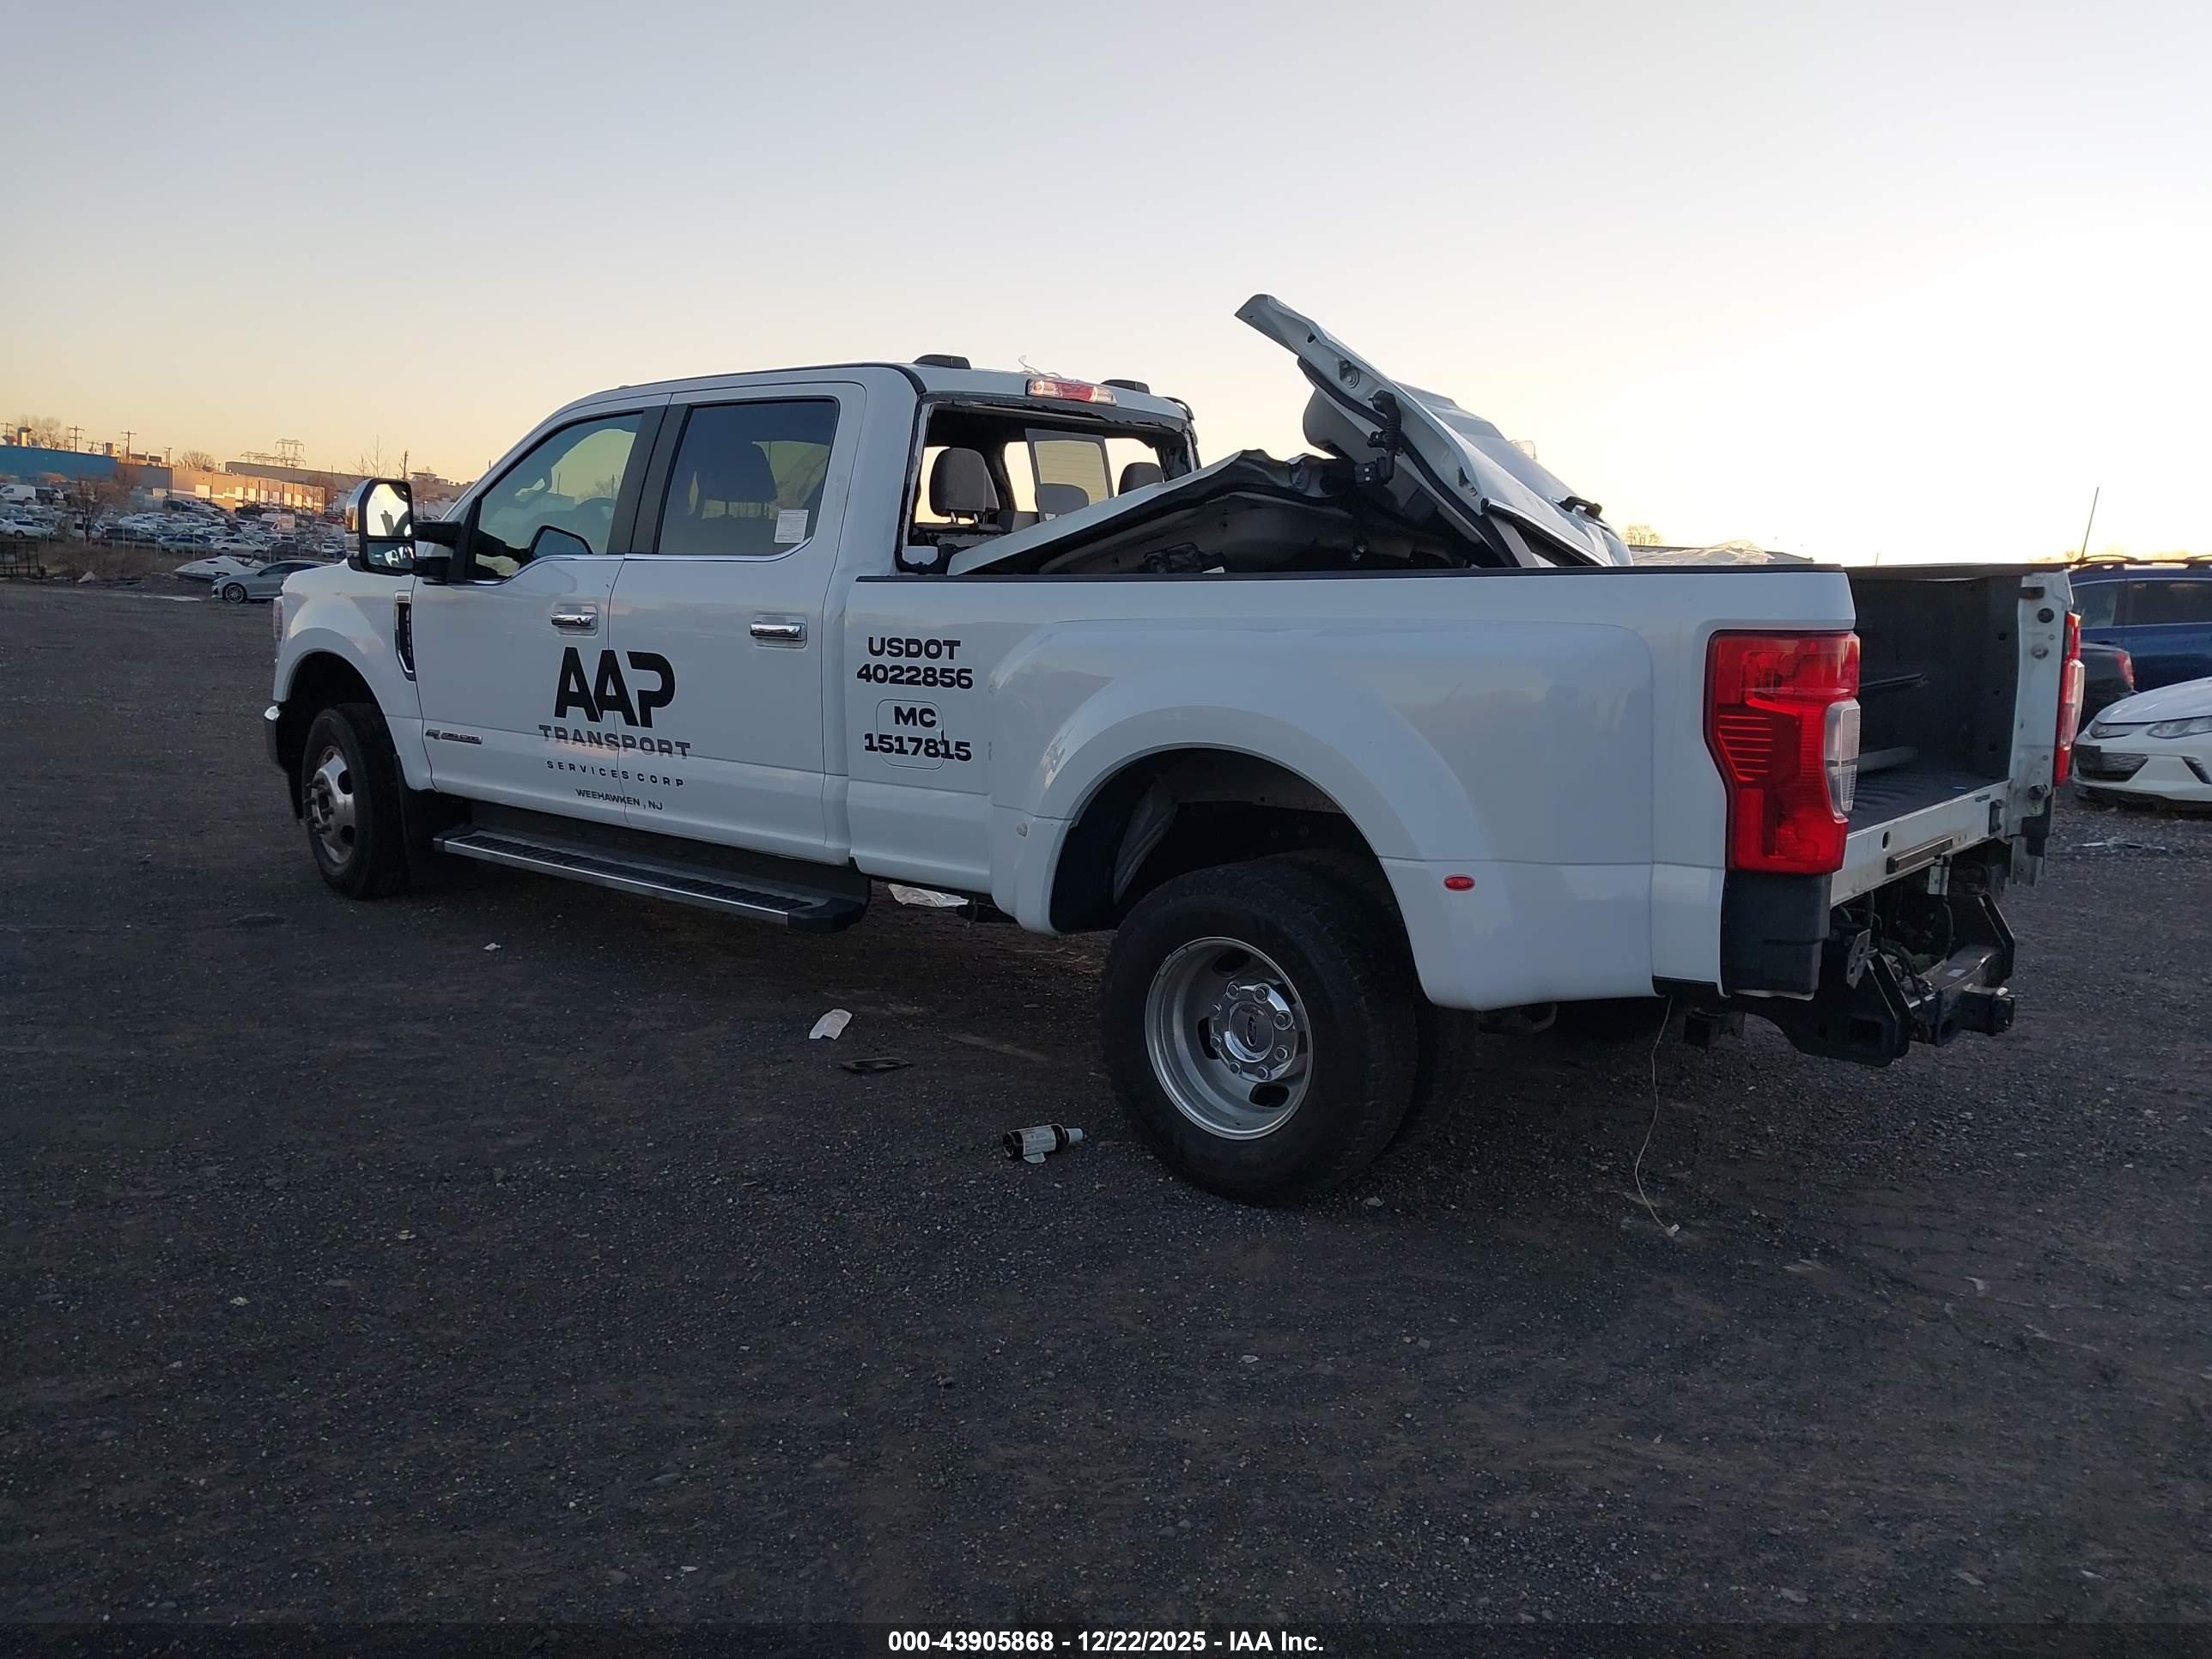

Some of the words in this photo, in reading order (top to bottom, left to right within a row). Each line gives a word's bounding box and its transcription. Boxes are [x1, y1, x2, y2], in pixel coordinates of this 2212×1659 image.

[867, 636, 962, 660] USDOT
[554, 646, 676, 729] AAP
[856, 663, 974, 690] 4022856
[893, 705, 937, 728] MC
[538, 724, 691, 759] TRANSPORT
[864, 732, 972, 762] 1517815
[546, 760, 630, 780] SERVICES
[636, 772, 684, 787] CORP
[647, 799, 664, 811] NJ
